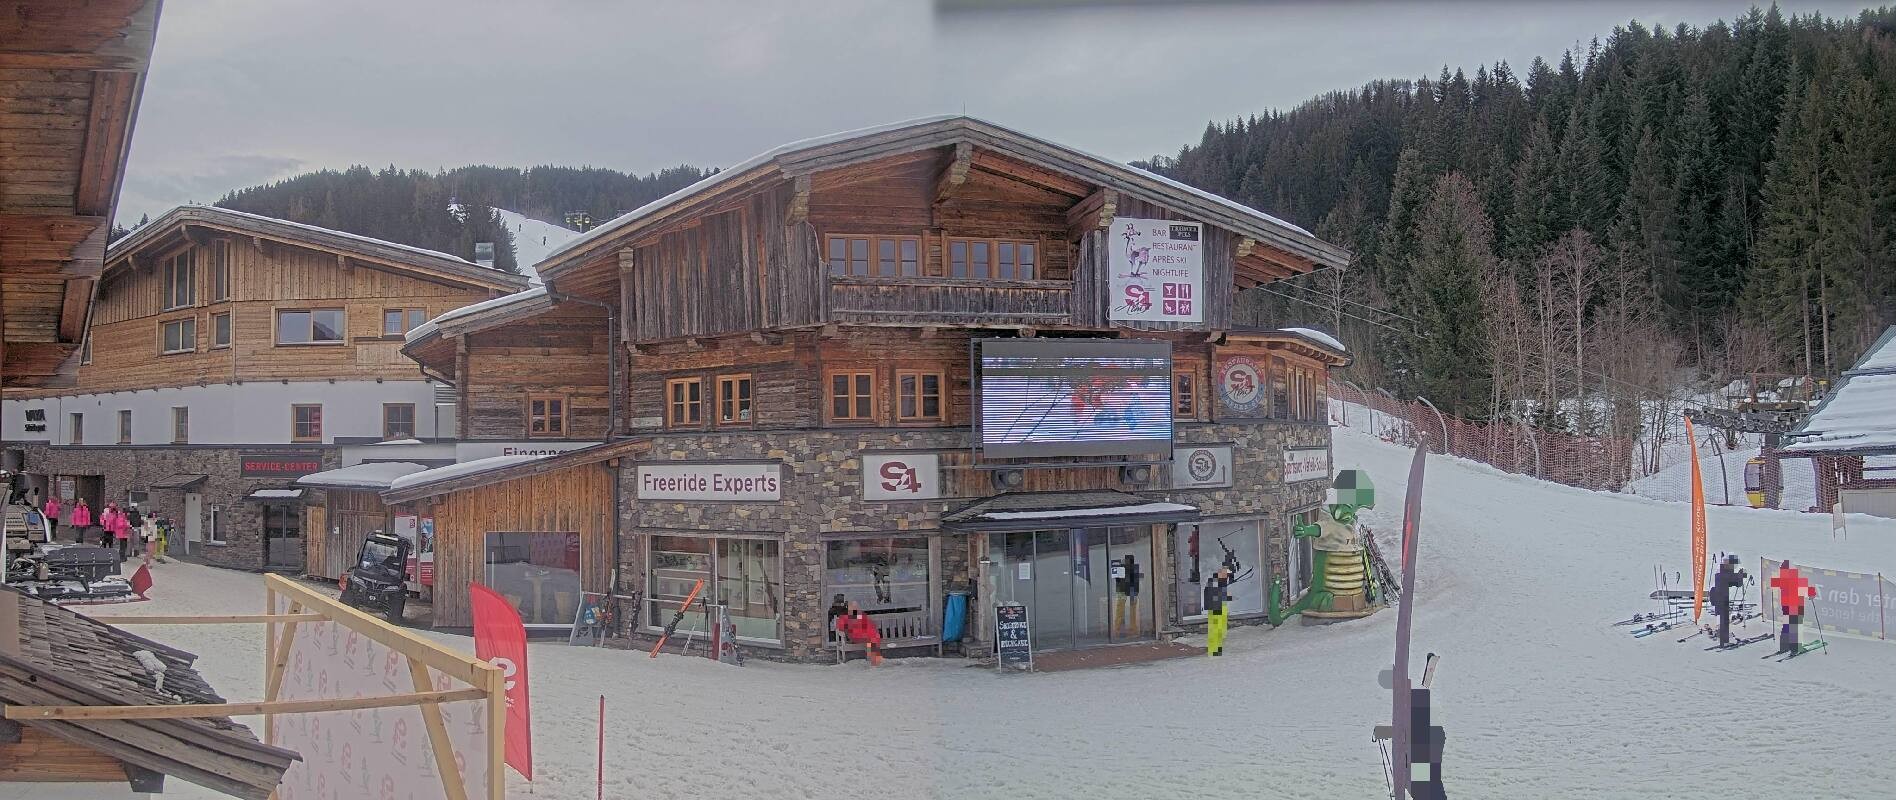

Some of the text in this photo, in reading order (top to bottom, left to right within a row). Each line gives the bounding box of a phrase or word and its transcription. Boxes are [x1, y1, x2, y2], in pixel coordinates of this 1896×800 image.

[1152, 229, 1167, 237] BAR
[1152, 242, 1197, 251] RESTAURANT
[1152, 269, 1189, 278] NIGHTLIFE
[643, 473, 777, 495] Freeride Experts
